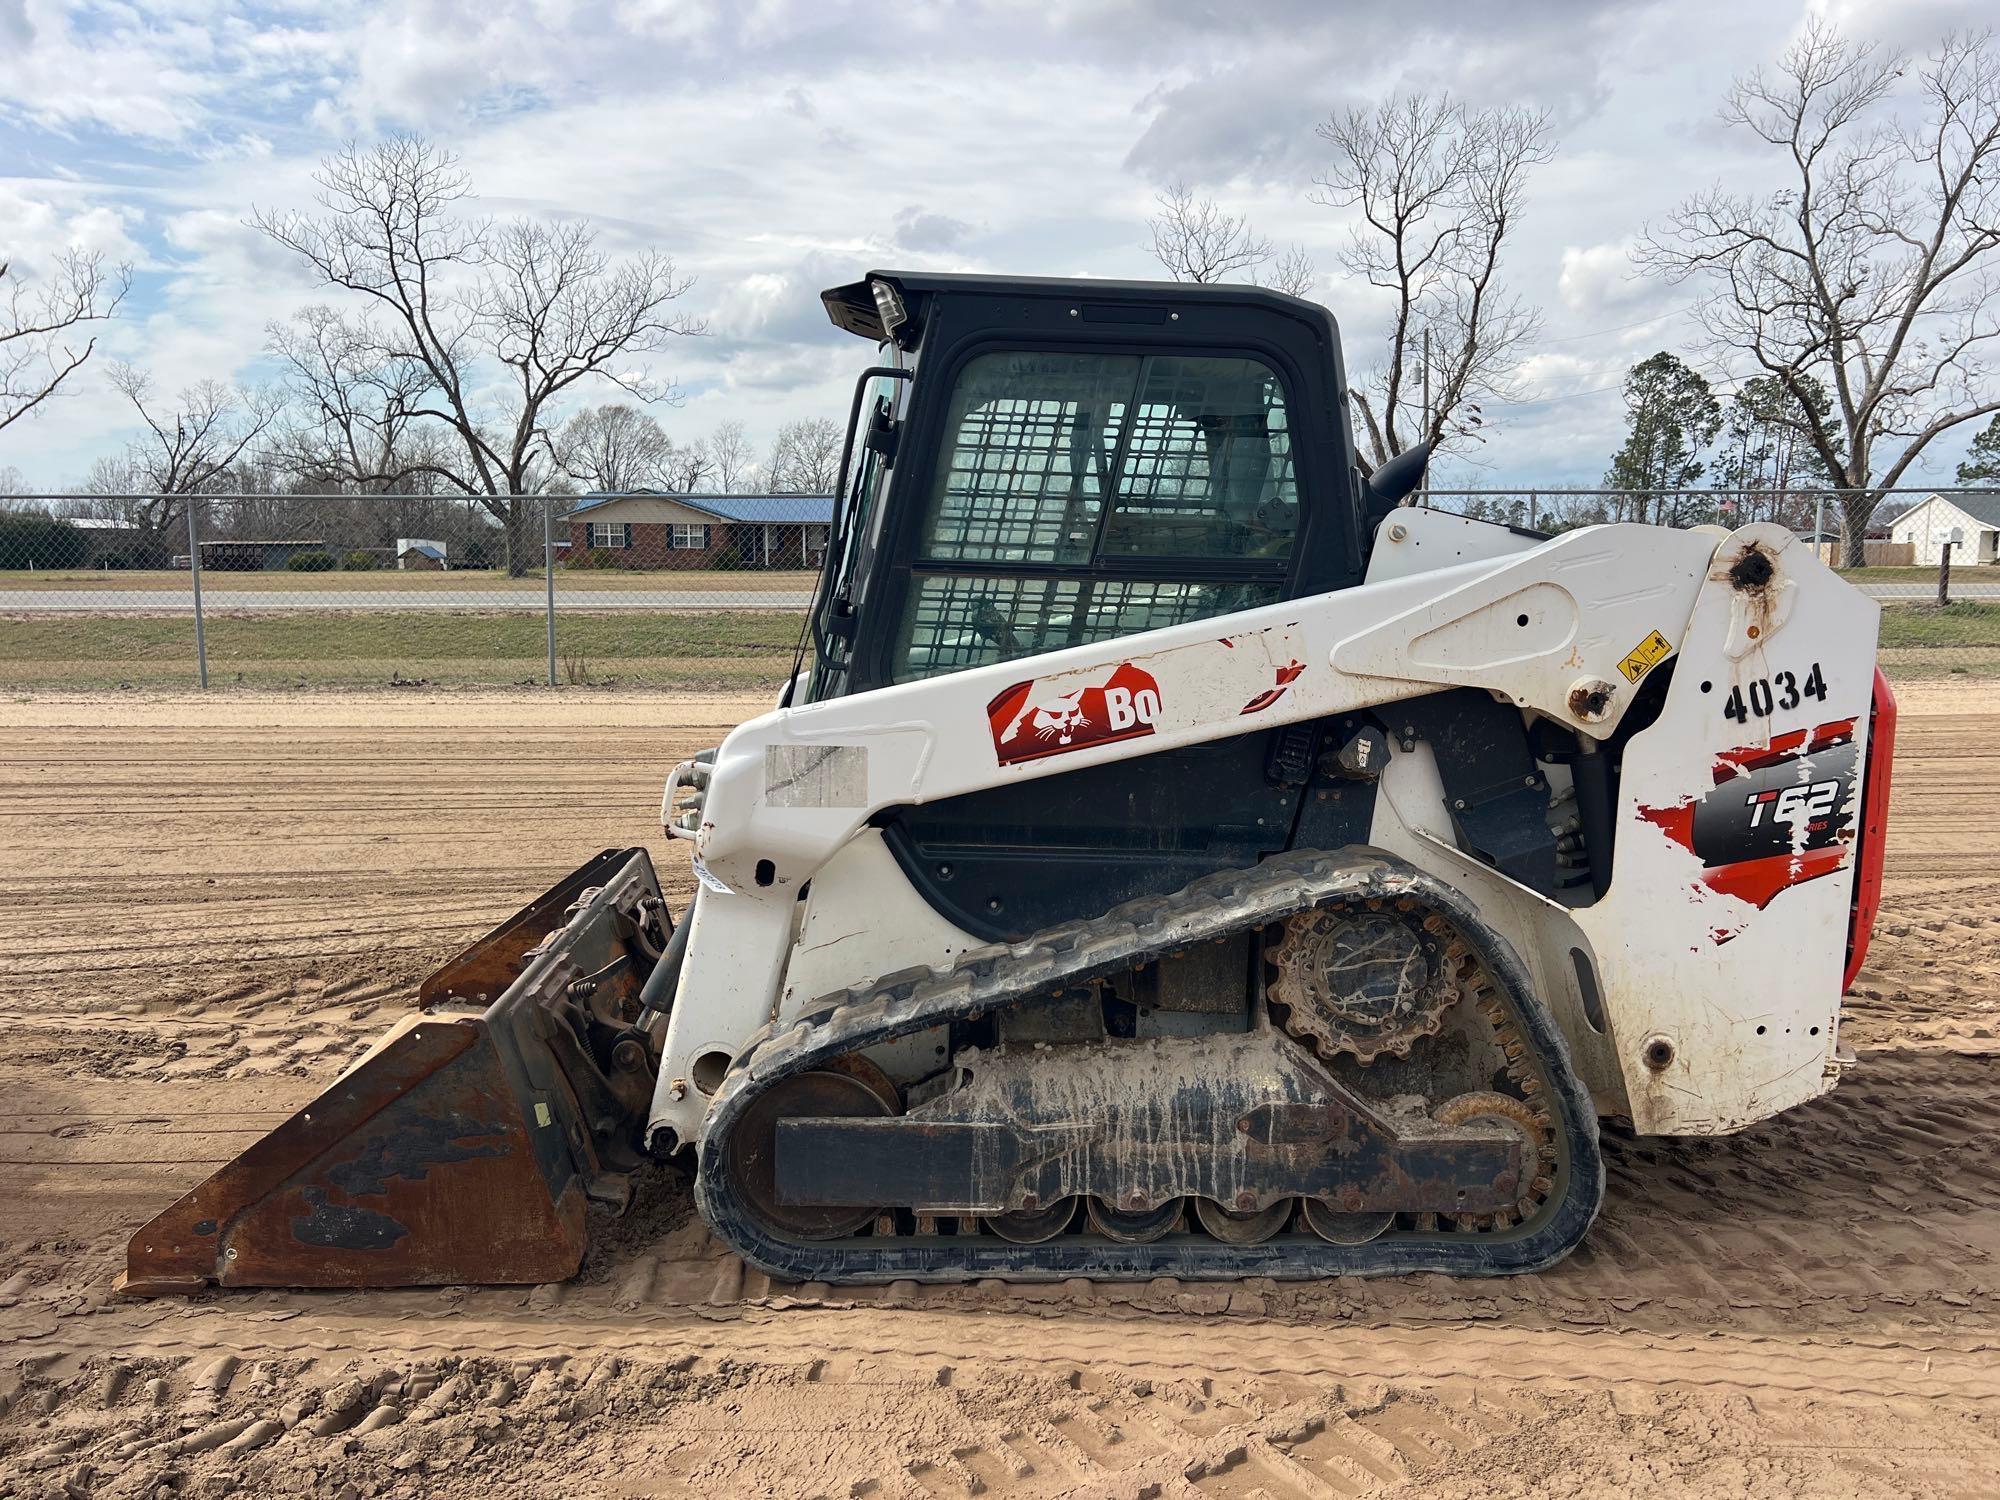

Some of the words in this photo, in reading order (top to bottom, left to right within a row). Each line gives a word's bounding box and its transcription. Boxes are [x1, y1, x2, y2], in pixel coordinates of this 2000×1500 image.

[1723, 662, 1828, 724] 4034
[1746, 780, 1839, 828] T62
[1803, 820, 1829, 832] RIES
